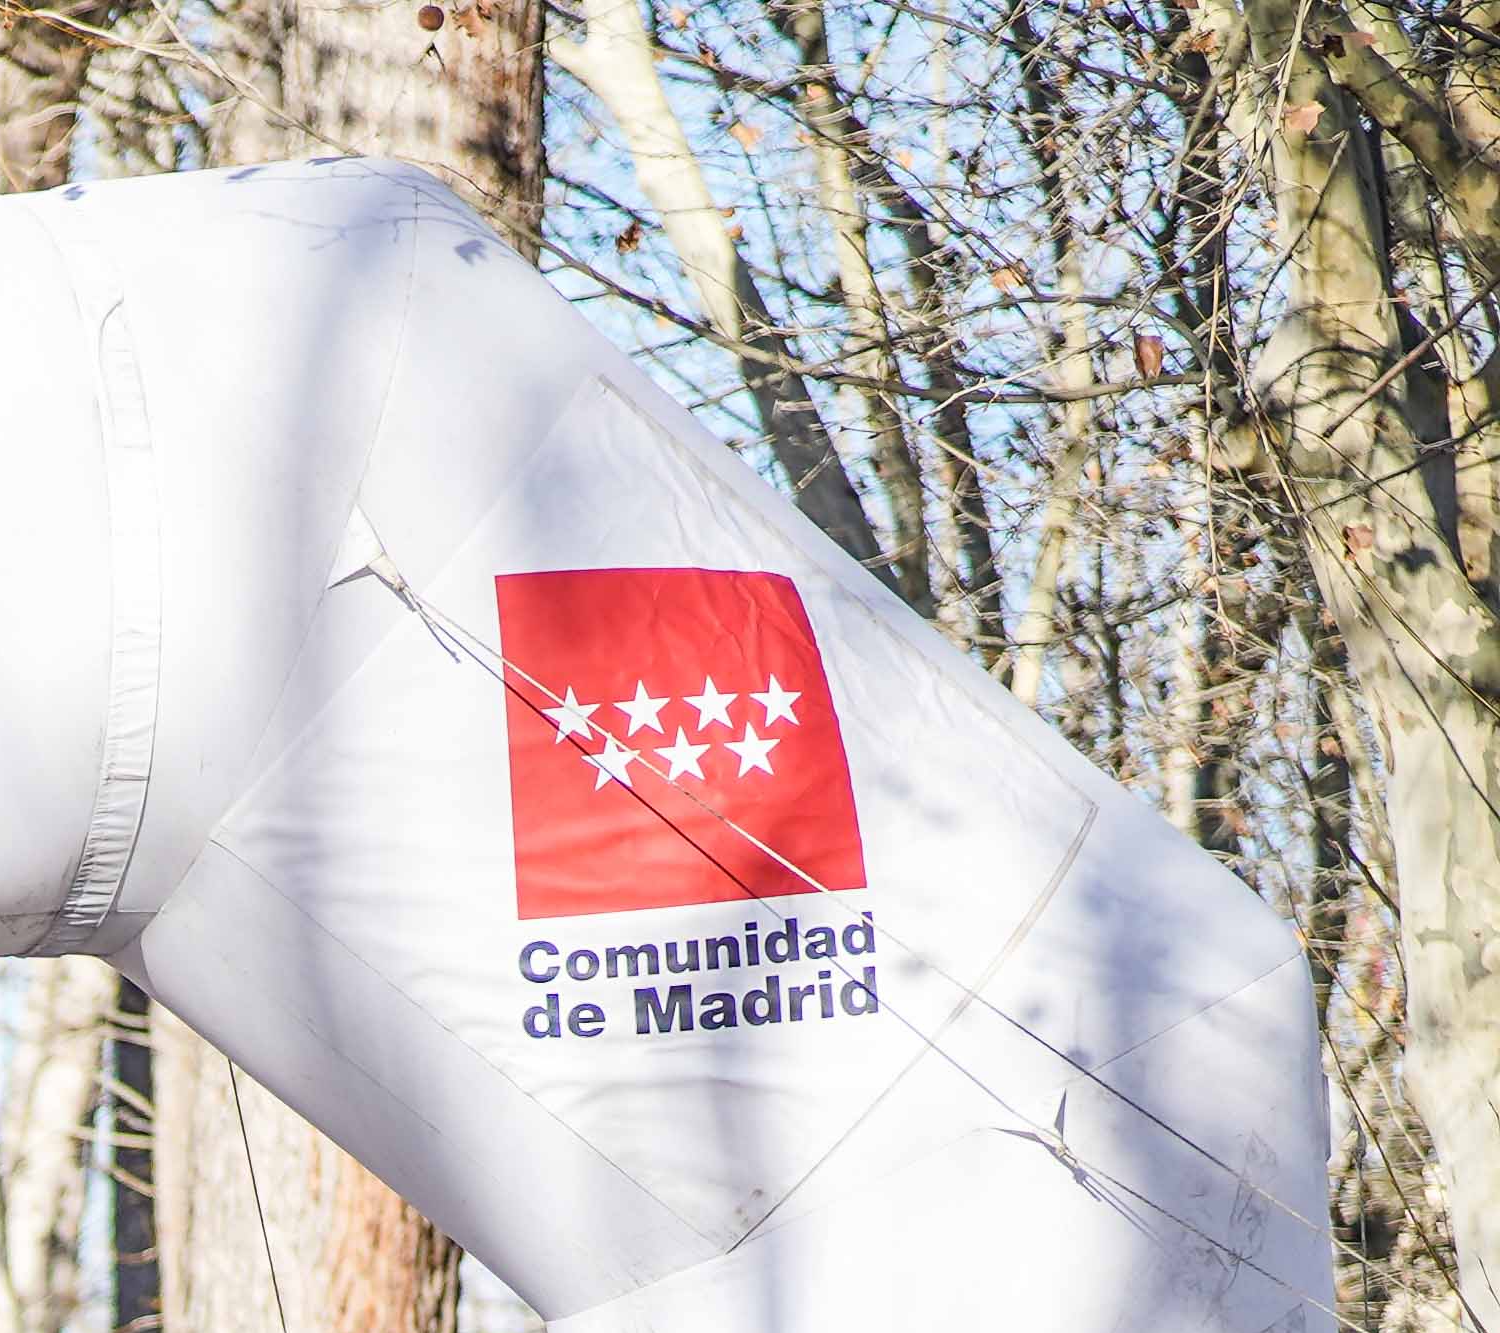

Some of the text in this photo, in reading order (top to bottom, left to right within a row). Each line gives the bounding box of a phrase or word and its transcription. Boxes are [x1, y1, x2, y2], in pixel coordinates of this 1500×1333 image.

[518, 911, 876, 984] Comunidad
[522, 966, 879, 1039] de Madrid
